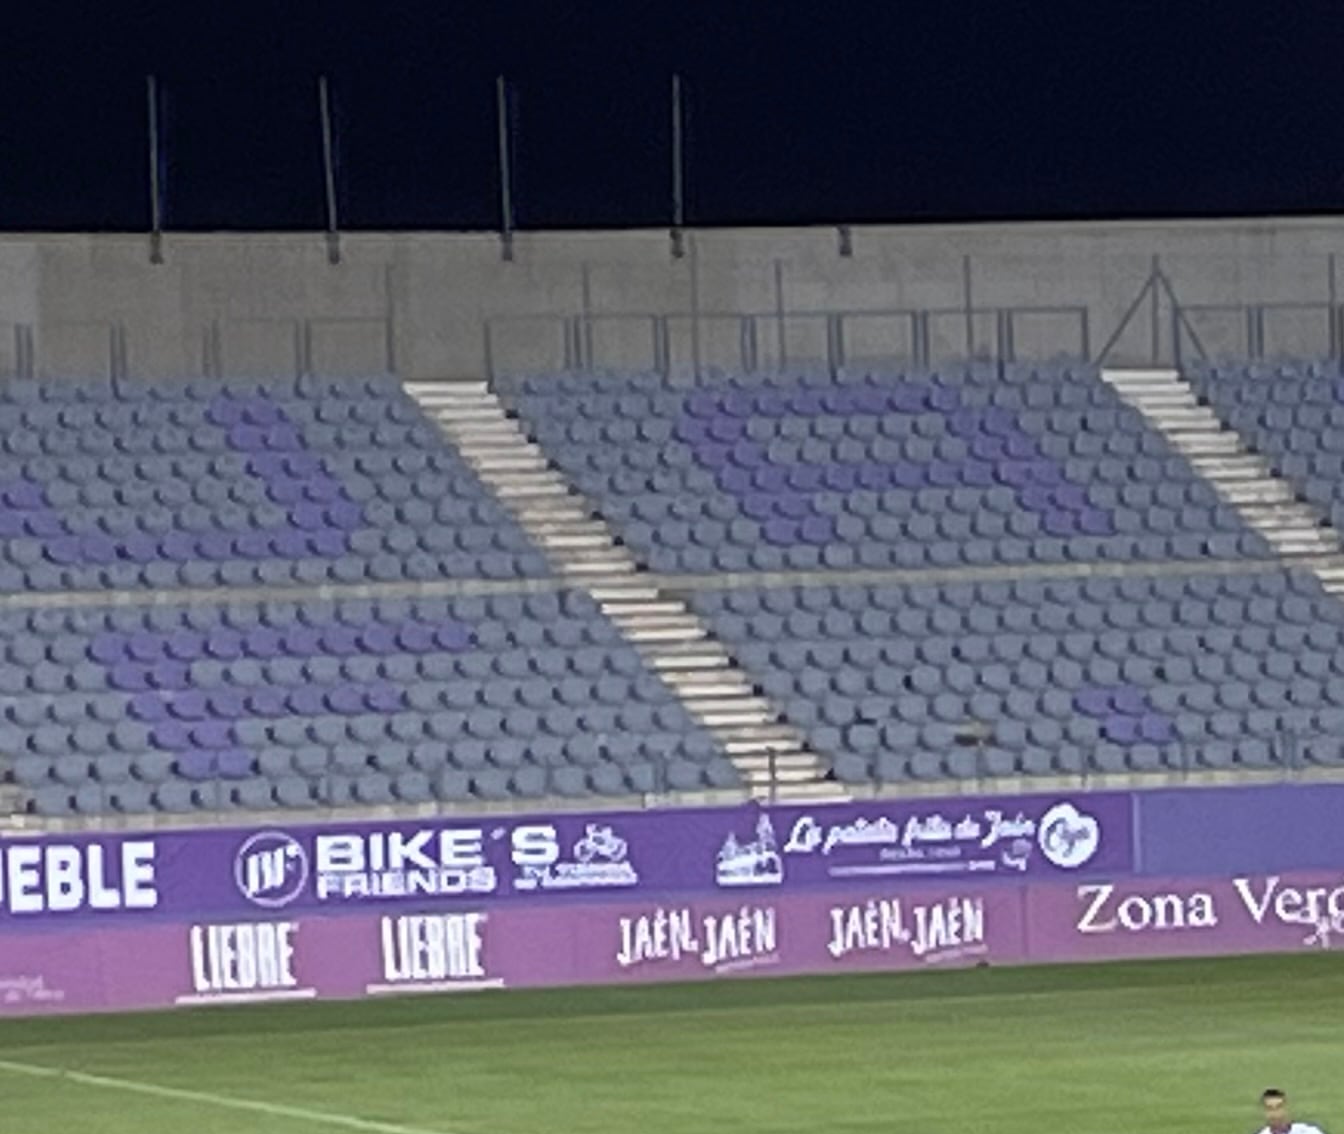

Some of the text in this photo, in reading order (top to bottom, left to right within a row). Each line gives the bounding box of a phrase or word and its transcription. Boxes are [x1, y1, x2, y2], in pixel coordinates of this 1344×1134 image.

[0, 841, 158, 914] EBLE
[316, 866, 498, 899] FRIENDS
[1077, 884, 1218, 933] Zona
[190, 922, 298, 992] LIEBRE
[381, 912, 488, 981] LIEBRE
